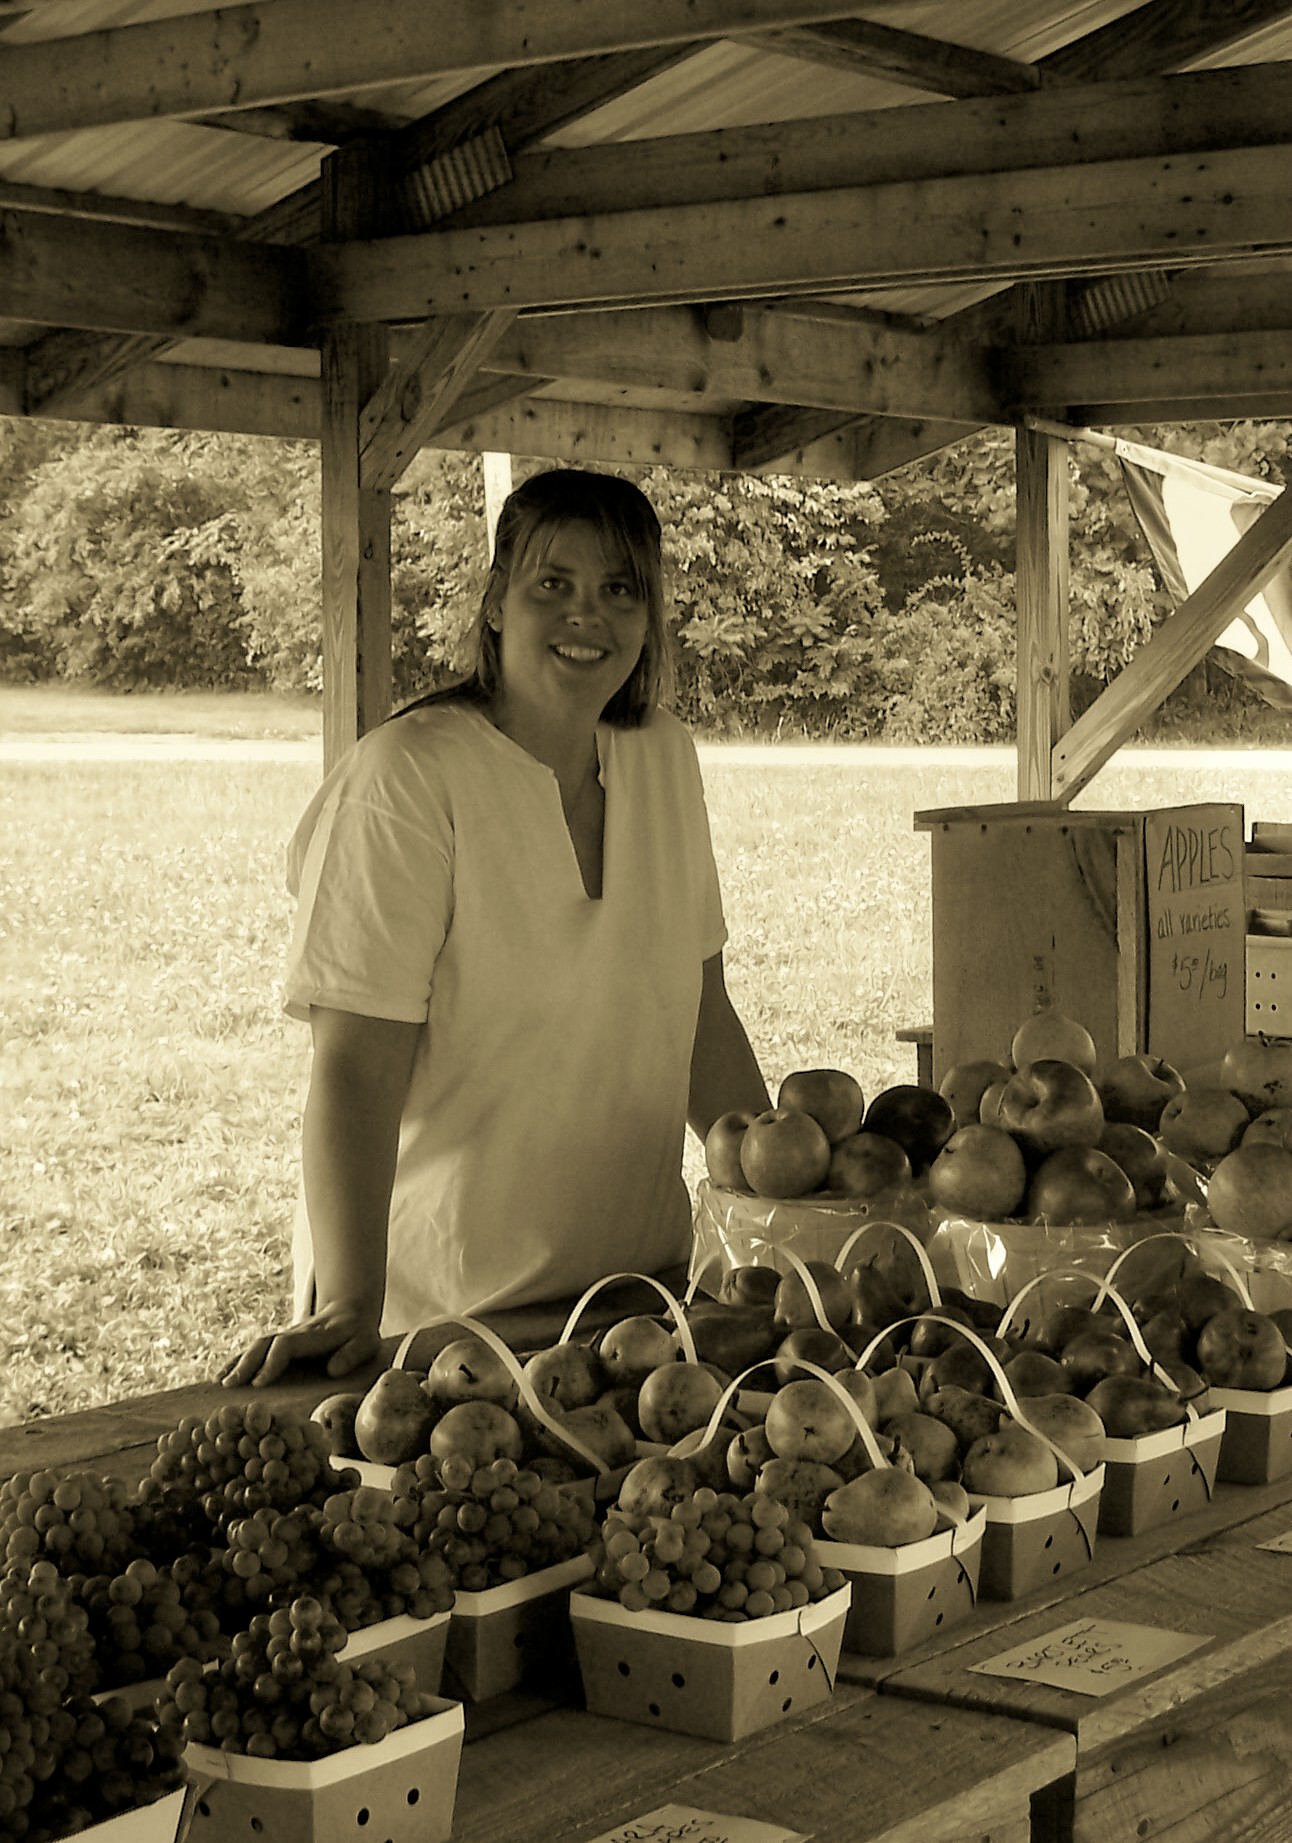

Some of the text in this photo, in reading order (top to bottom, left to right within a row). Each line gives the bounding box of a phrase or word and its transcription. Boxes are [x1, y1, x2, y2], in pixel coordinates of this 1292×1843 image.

[1157, 826, 1234, 893] APPLES
[1157, 904, 1231, 939] all varieties
